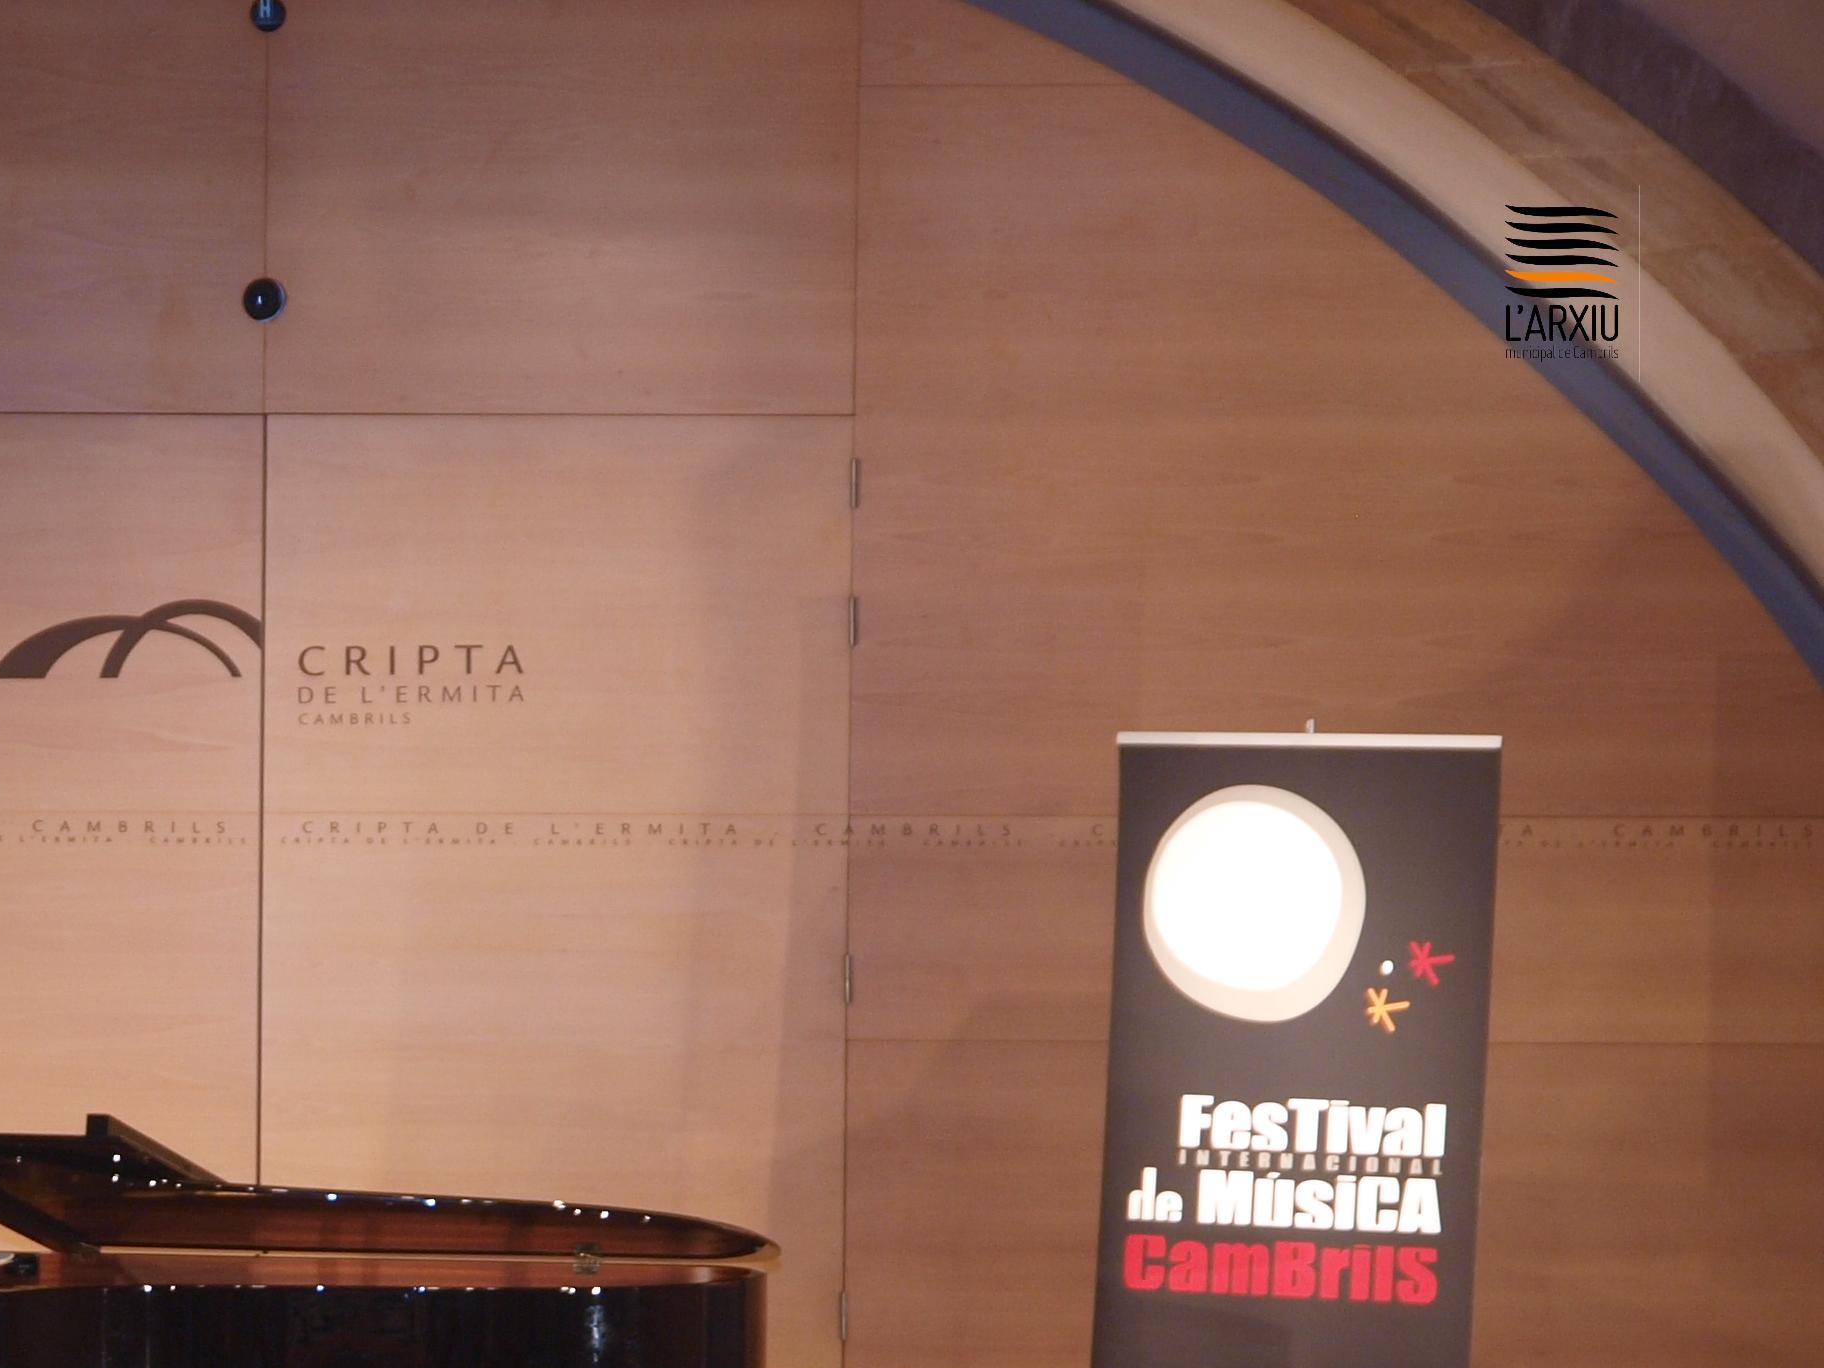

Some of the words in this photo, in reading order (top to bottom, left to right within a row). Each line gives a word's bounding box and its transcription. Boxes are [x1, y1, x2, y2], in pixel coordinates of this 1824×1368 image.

[297, 644, 524, 677] CRIPTA
[297, 686, 337, 704] DE
[361, 684, 525, 704] L'ERMITA
[297, 711, 412, 726] CAMBRILS
[31, 819, 226, 834] CAMBRILS
[301, 820, 440, 834] CRIPTA
[475, 821, 514, 836] DE
[816, 822, 1012, 837] CAMBRILS
[1179, 1148, 1443, 1176] INTERNACIONAL
[1126, 1166, 1184, 1223] de
